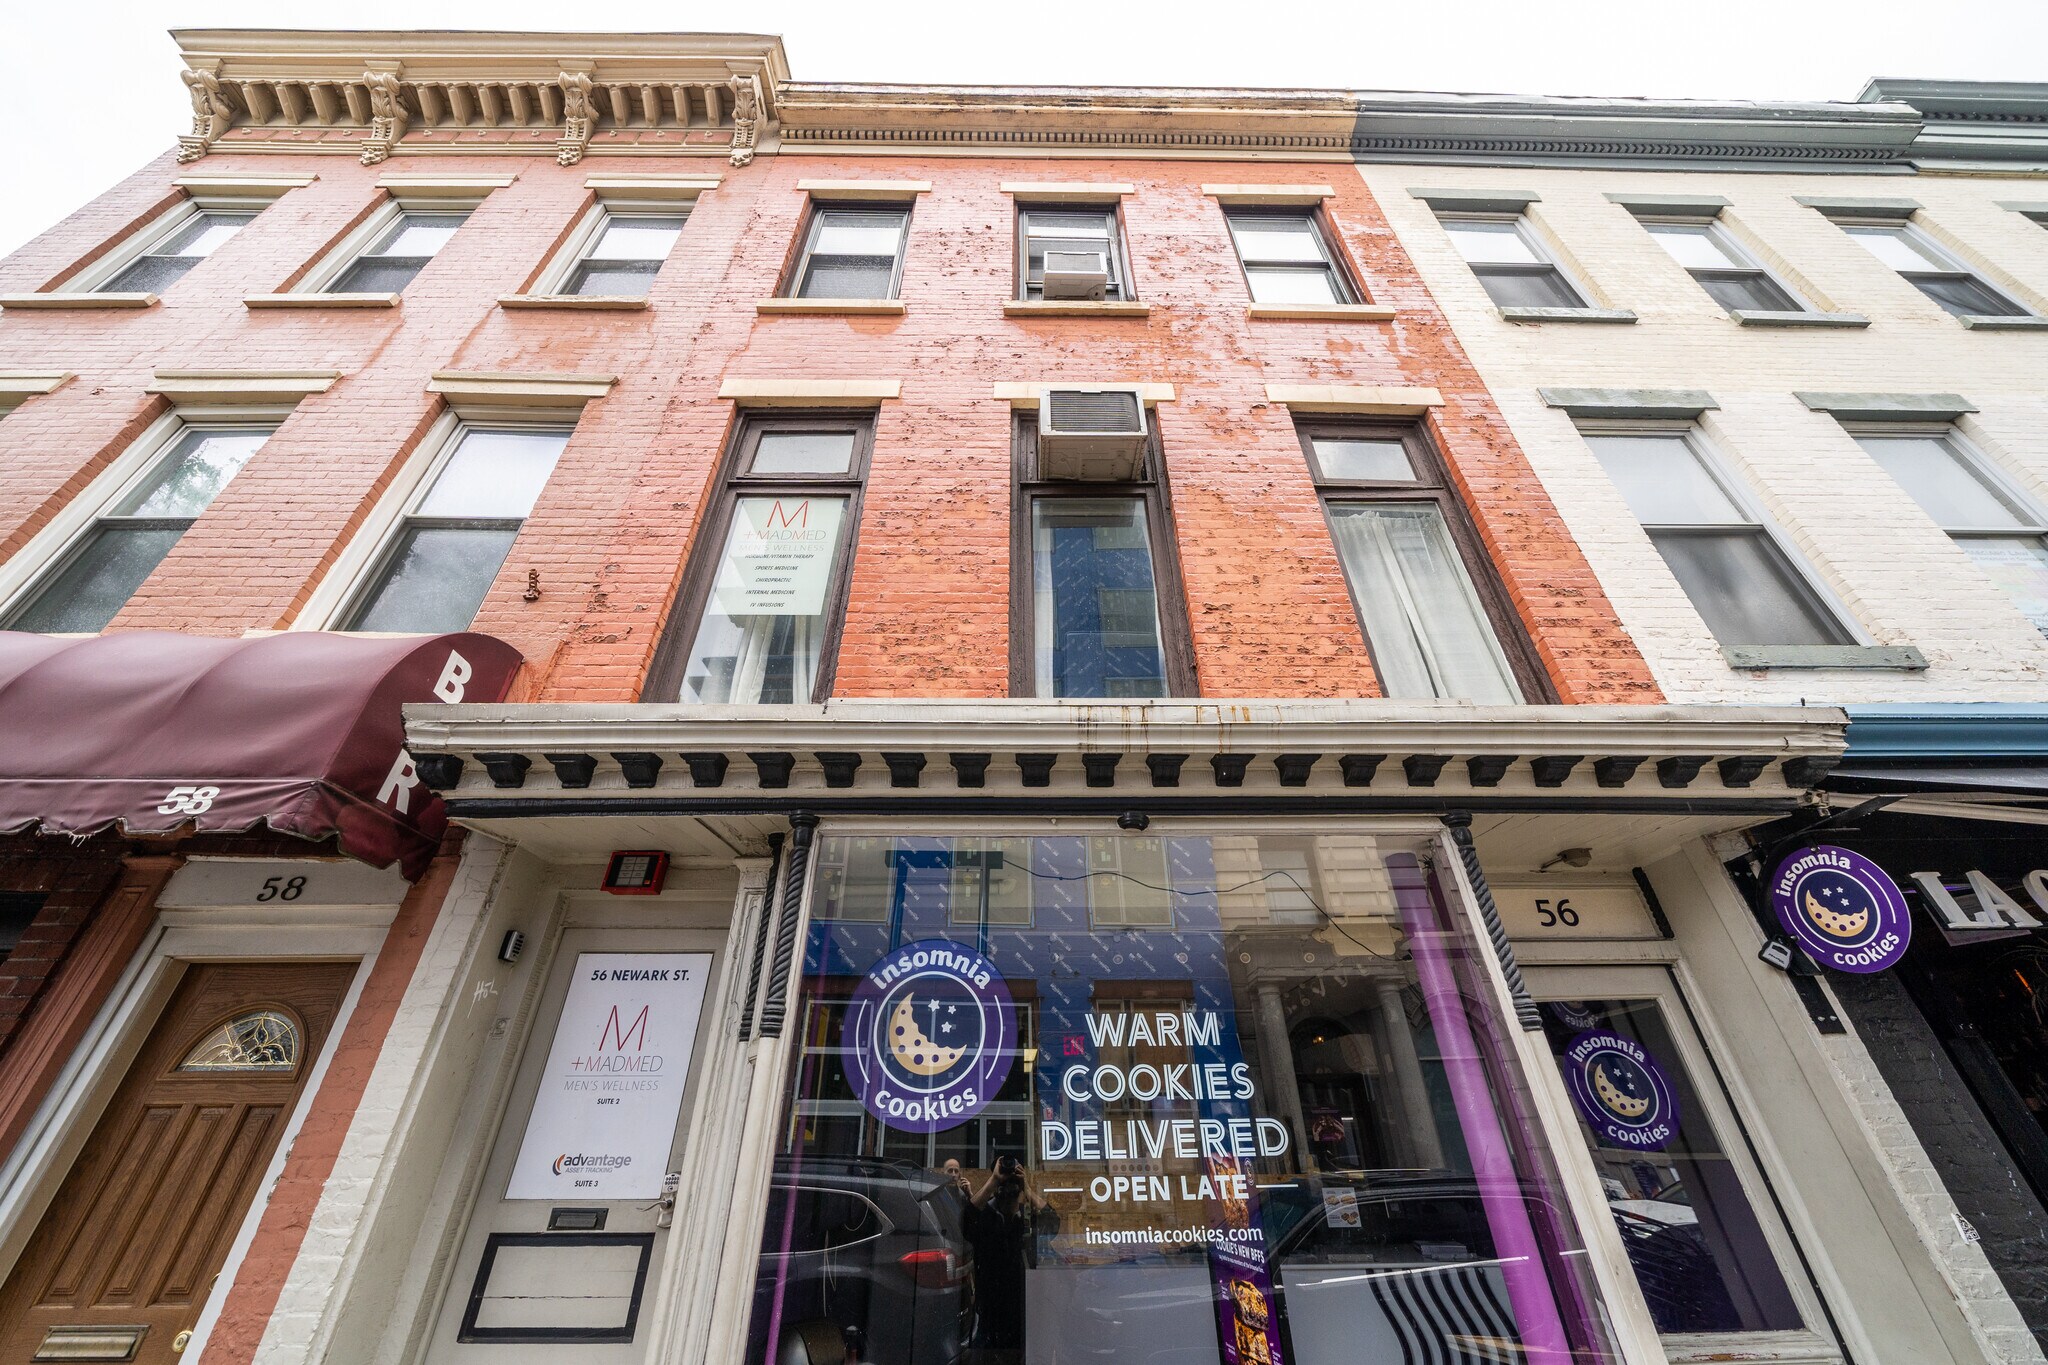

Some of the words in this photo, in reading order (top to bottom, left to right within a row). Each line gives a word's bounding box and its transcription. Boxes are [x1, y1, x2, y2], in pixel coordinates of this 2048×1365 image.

[766, 500, 808, 528] M
[773, 544, 825, 552] WELLNESS
[157, 786, 220, 815] 58
[1775, 851, 1851, 897] insomnia
[256, 876, 307, 902] 58
[1535, 899, 1580, 927] 56
[1833, 931, 1900, 966] cookies
[591, 970, 607, 981] 56
[611, 970, 670, 981] NEWARK
[673, 970, 690, 981] ST.
[869, 949, 991, 990] insomnia
[598, 1004, 649, 1052] M
[1085, 1012, 1221, 1047] WARM
[1569, 1036, 1646, 1063] insomnia
[563, 1080, 599, 1091] MEN'S
[602, 1080, 659, 1091] WELLNESS
[1063, 1063, 1255, 1102] COOKIES
[874, 1087, 978, 1121] cookies
[1041, 1118, 1289, 1160] DELIVERED
[1607, 1123, 1670, 1145] cookies
[564, 1153, 632, 1169] advantage
[1090, 1176, 1171, 1202] OPEN
[1181, 1174, 1250, 1201] LATE
[1085, 1225, 1264, 1244] insomniacookies.com
[1238, 1244, 1250, 1259] NEW
